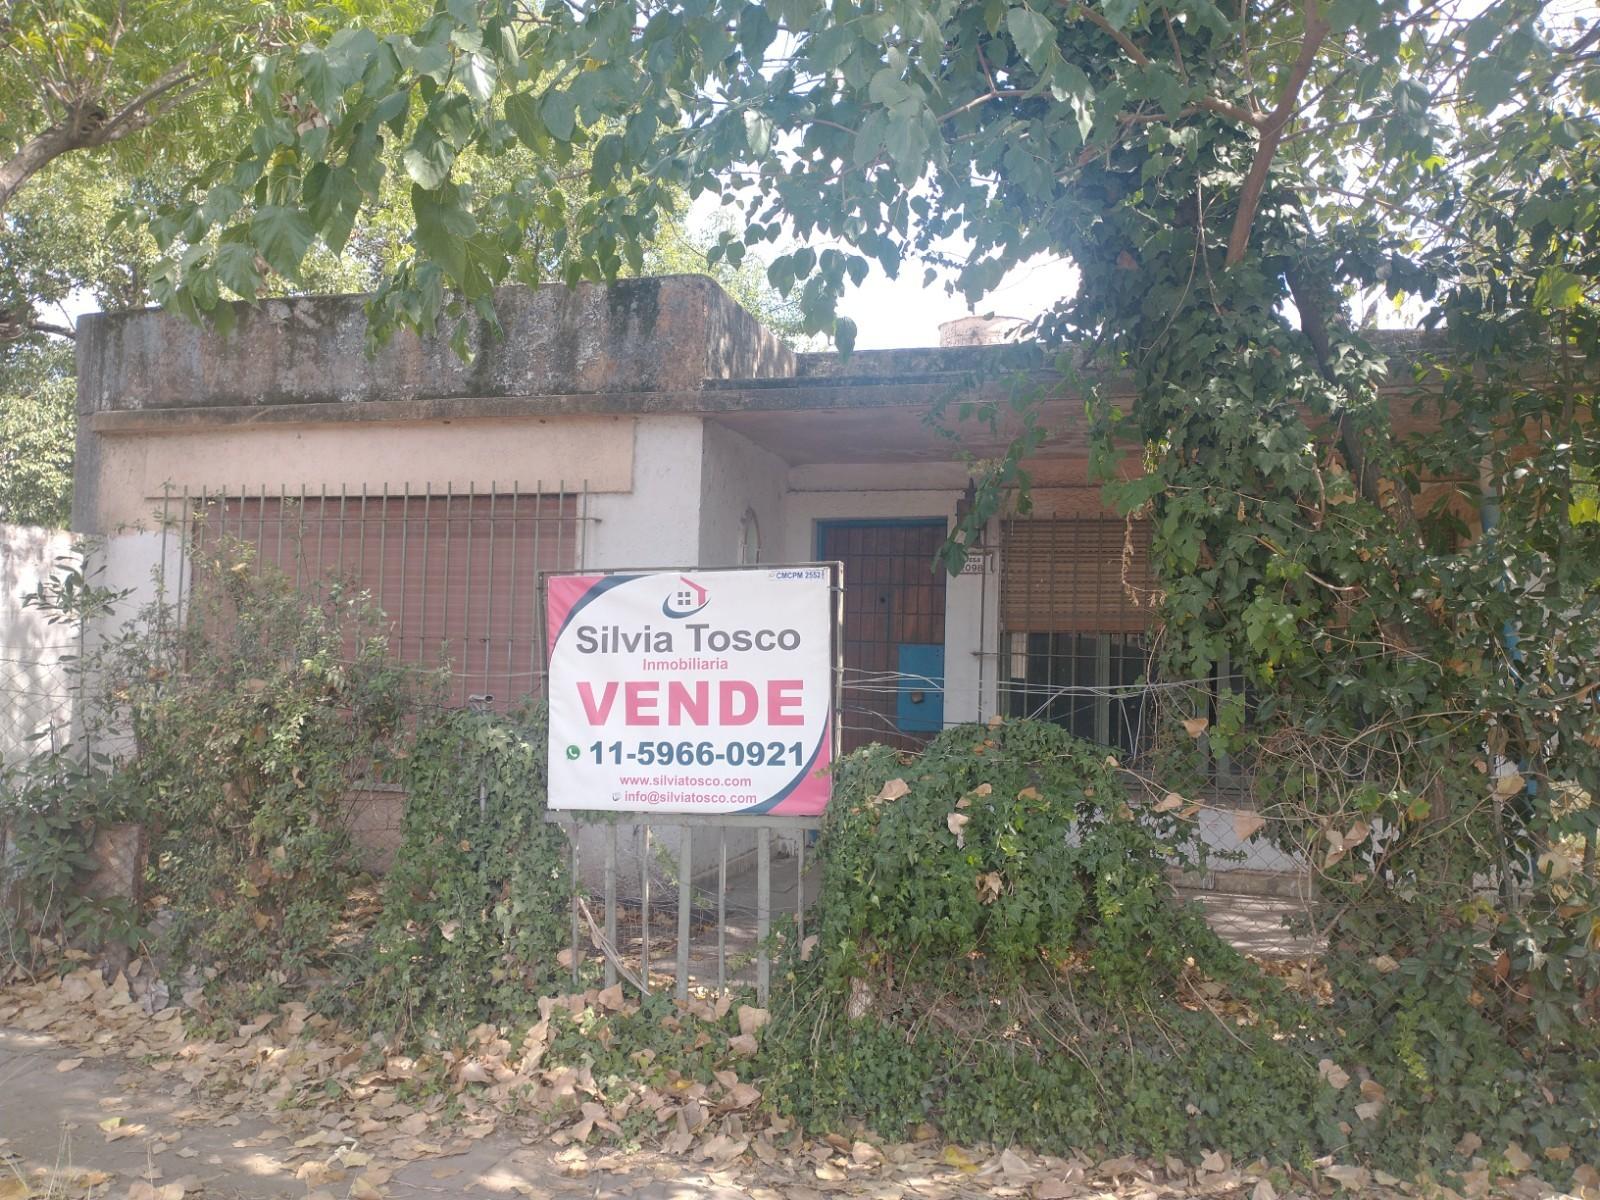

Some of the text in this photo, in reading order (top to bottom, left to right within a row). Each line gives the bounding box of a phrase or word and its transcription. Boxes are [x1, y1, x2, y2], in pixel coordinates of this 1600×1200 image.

[576, 623, 801, 654] Silvia Tosco
[643, 657, 728, 671] Inmobiliaria
[576, 679, 805, 727] VENDE
[589, 740, 803, 767] 11-5966-0921
[619, 775, 752, 787] www.silviatosco.com
[624, 791, 757, 804] info@silviatosco.com
